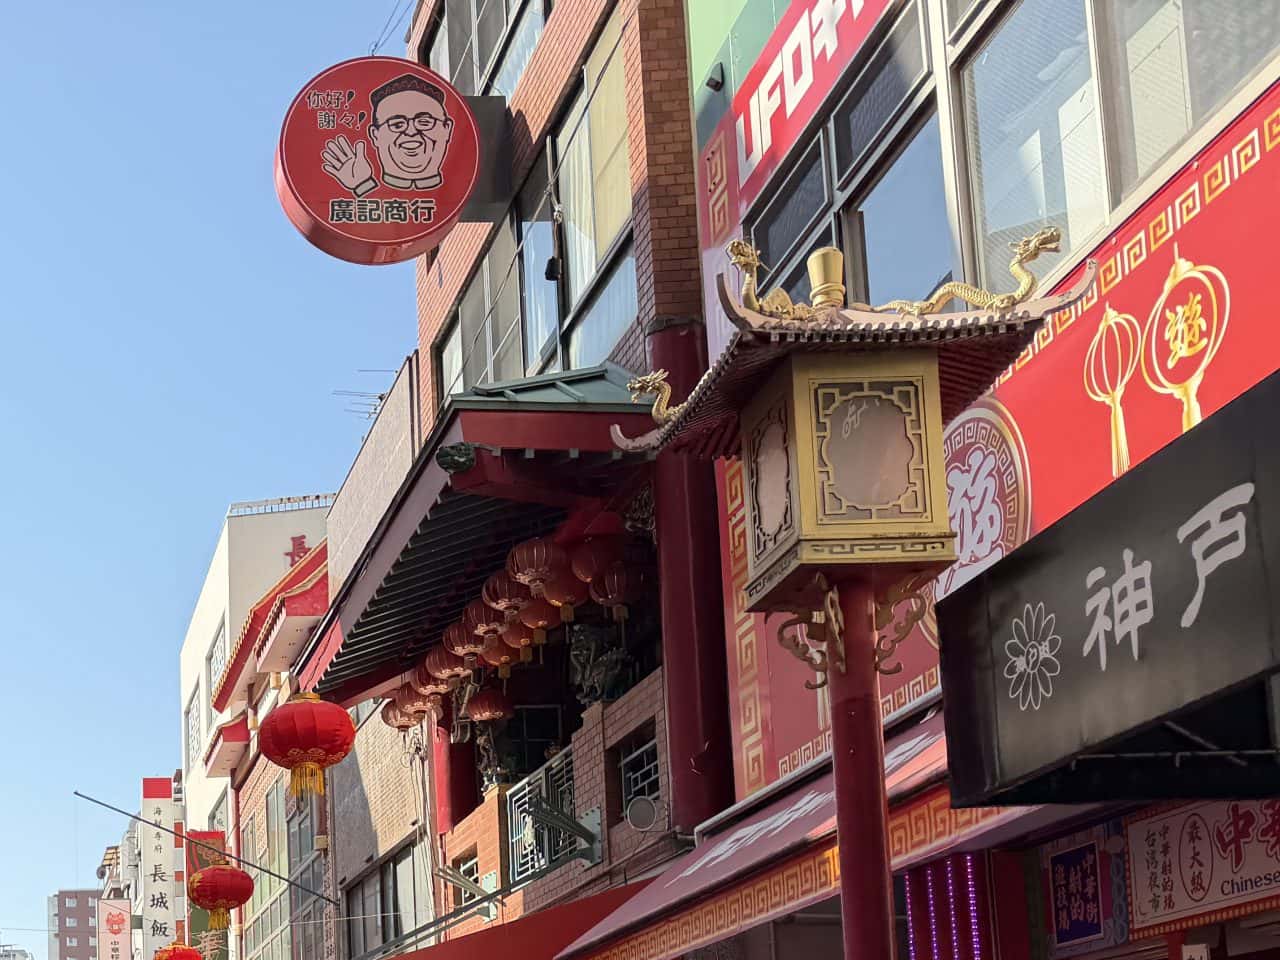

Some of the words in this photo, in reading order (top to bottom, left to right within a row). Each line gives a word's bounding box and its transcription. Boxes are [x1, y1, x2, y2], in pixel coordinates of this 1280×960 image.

[735, 0, 865, 188] UFOキ
[329, 198, 437, 223] 廣記商行
[1082, 482, 1255, 671] 神戸
[149, 863, 170, 950] 長城飯
[1221, 872, 1280, 896] Chinese
